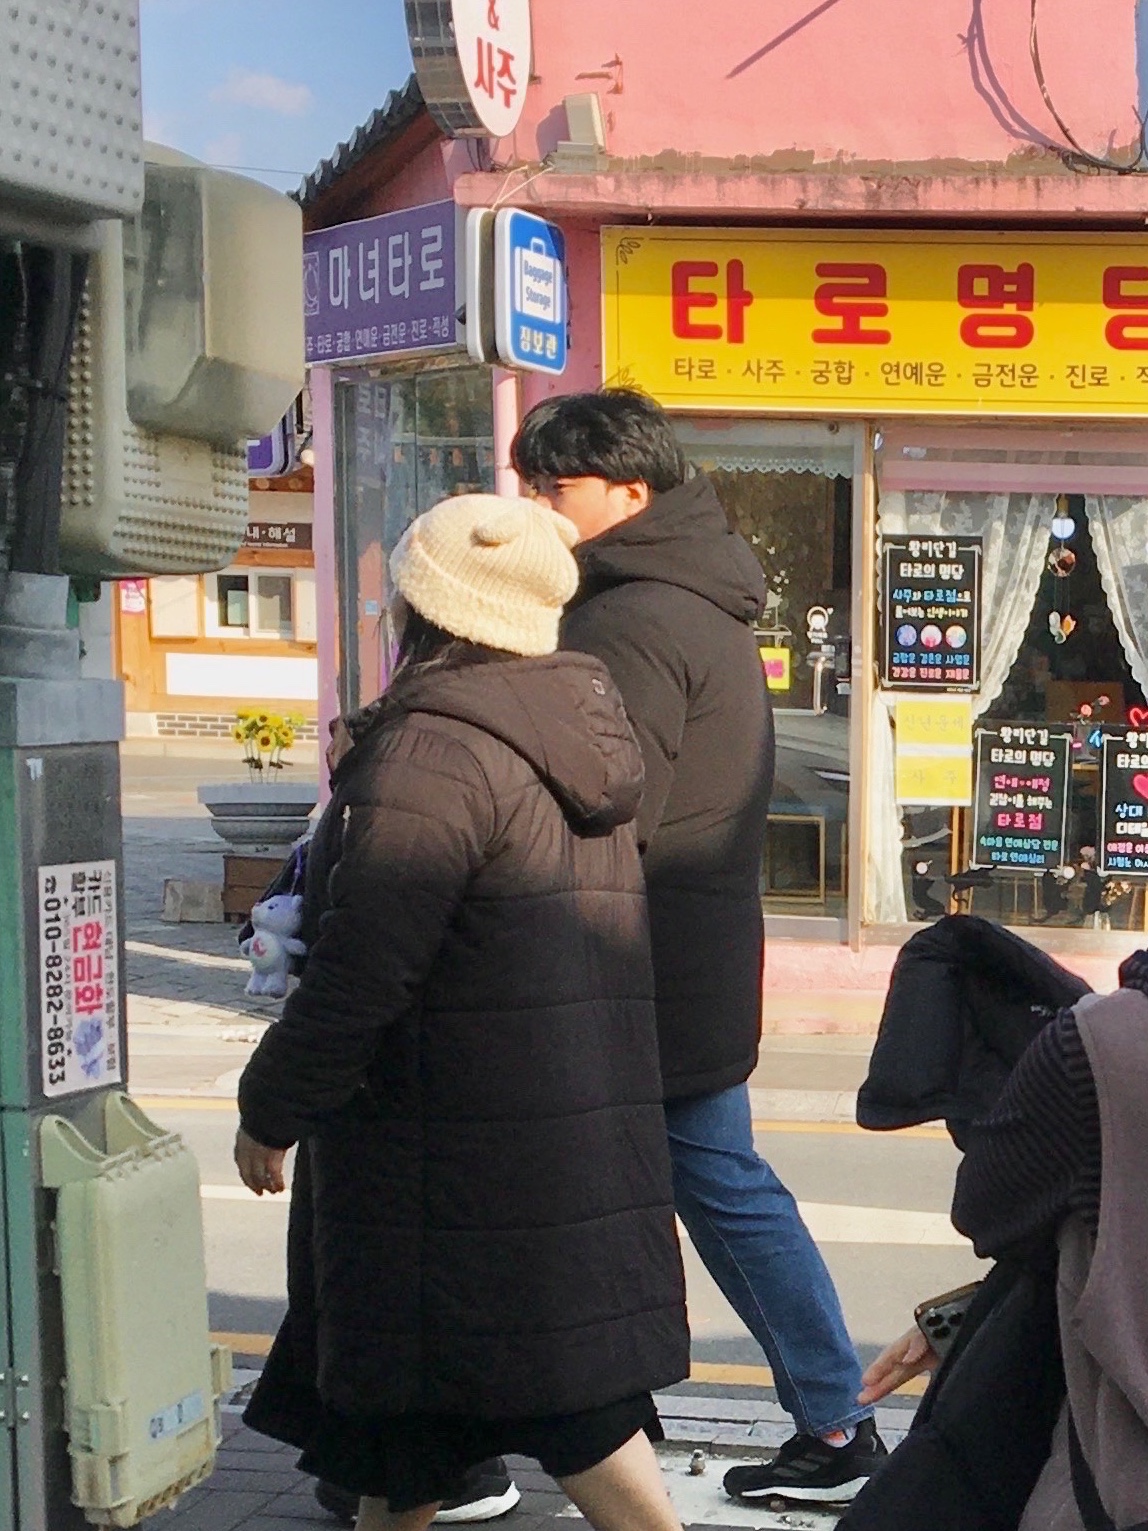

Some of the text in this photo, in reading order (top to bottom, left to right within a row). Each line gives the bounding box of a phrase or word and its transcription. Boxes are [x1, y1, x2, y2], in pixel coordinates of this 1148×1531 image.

[474, 36, 517, 109] 사주
[328, 225, 445, 310] 마녀타로
[674, 356, 718, 383] 타로
[741, 358, 787, 384] 사주
[809, 359, 855, 386] 궁합
[880, 360, 948, 387] 연예운
[971, 362, 1040, 389] 금전운
[1065, 363, 1110, 389] 진로
[899, 563, 965, 581] 타로의 명당
[990, 748, 1056, 767] 타로의 명당
[71, 871, 86, 918] 할부
[71, 869, 105, 1016] 카드 현금화
[43, 898, 67, 1086] 010-8282-8633
